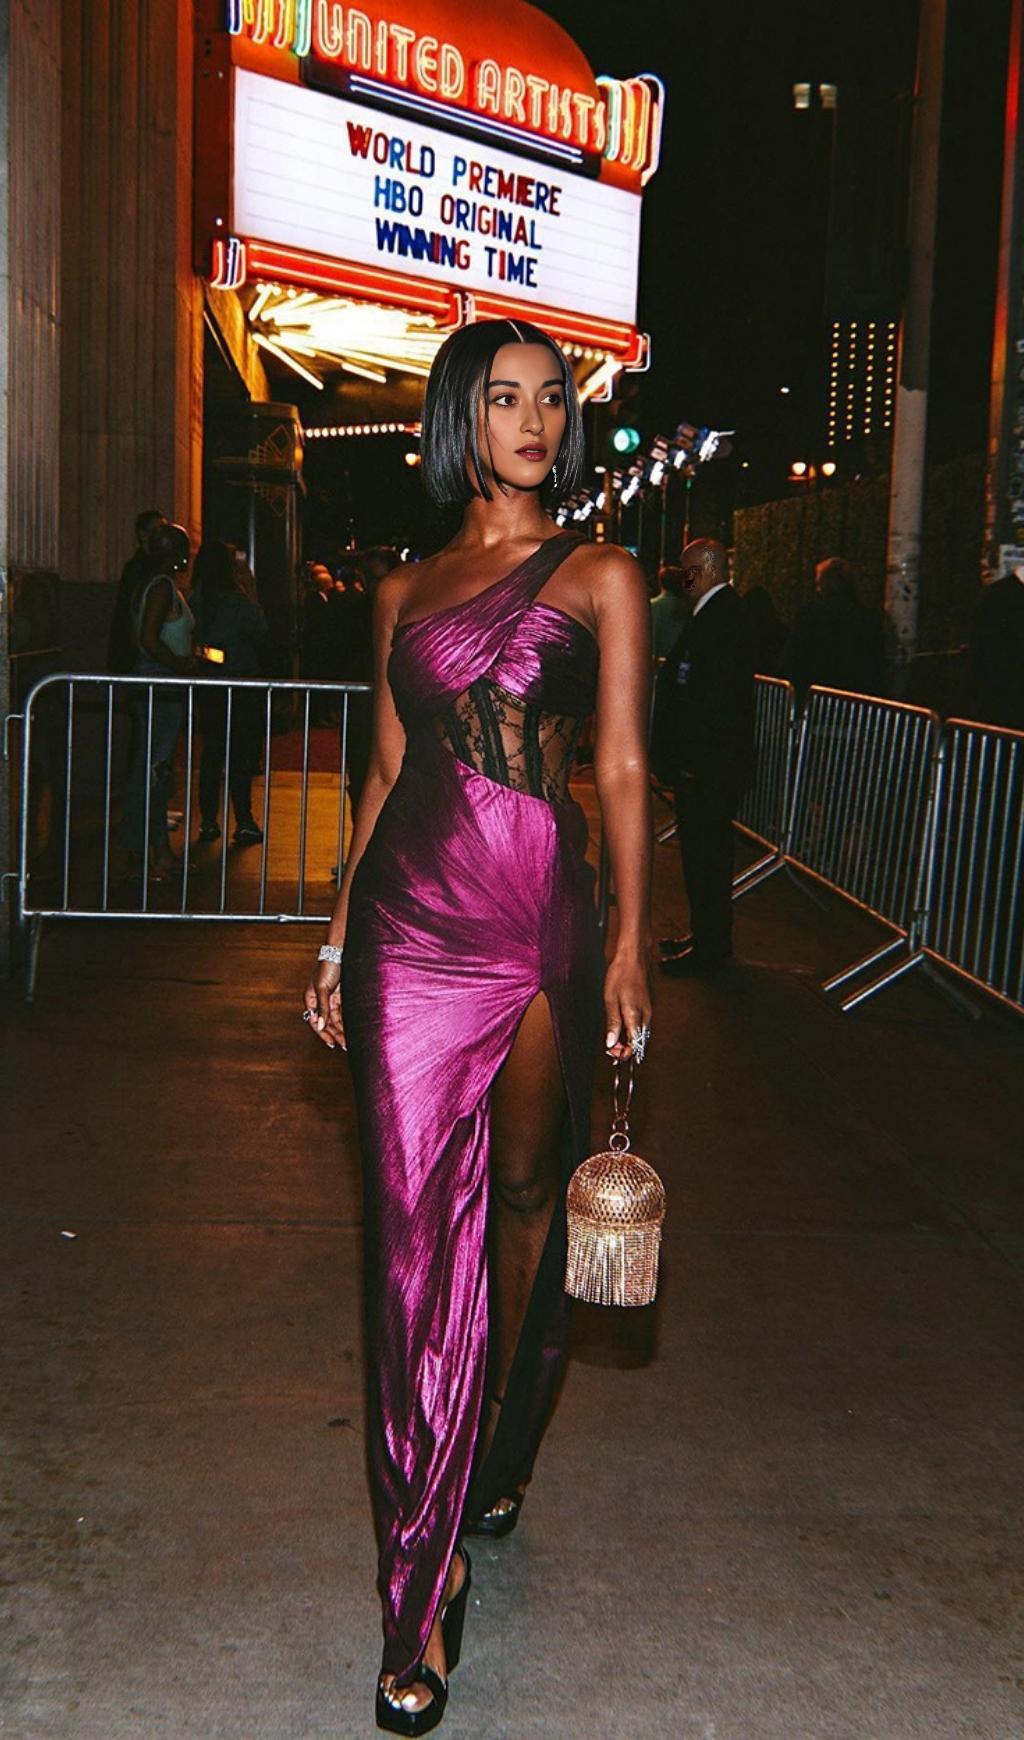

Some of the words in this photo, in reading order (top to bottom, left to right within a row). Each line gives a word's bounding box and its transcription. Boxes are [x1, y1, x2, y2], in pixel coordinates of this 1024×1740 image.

[318, 0, 465, 98] UNITED
[478, 59, 606, 150] ARTISTS
[346, 121, 435, 178] WORLD
[452, 155, 562, 216] PREMIERE
[374, 175, 423, 217] HBO
[440, 194, 542, 250] ORIGINAL
[375, 217, 471, 270] WINNING
[484, 246, 538, 288] TIME
